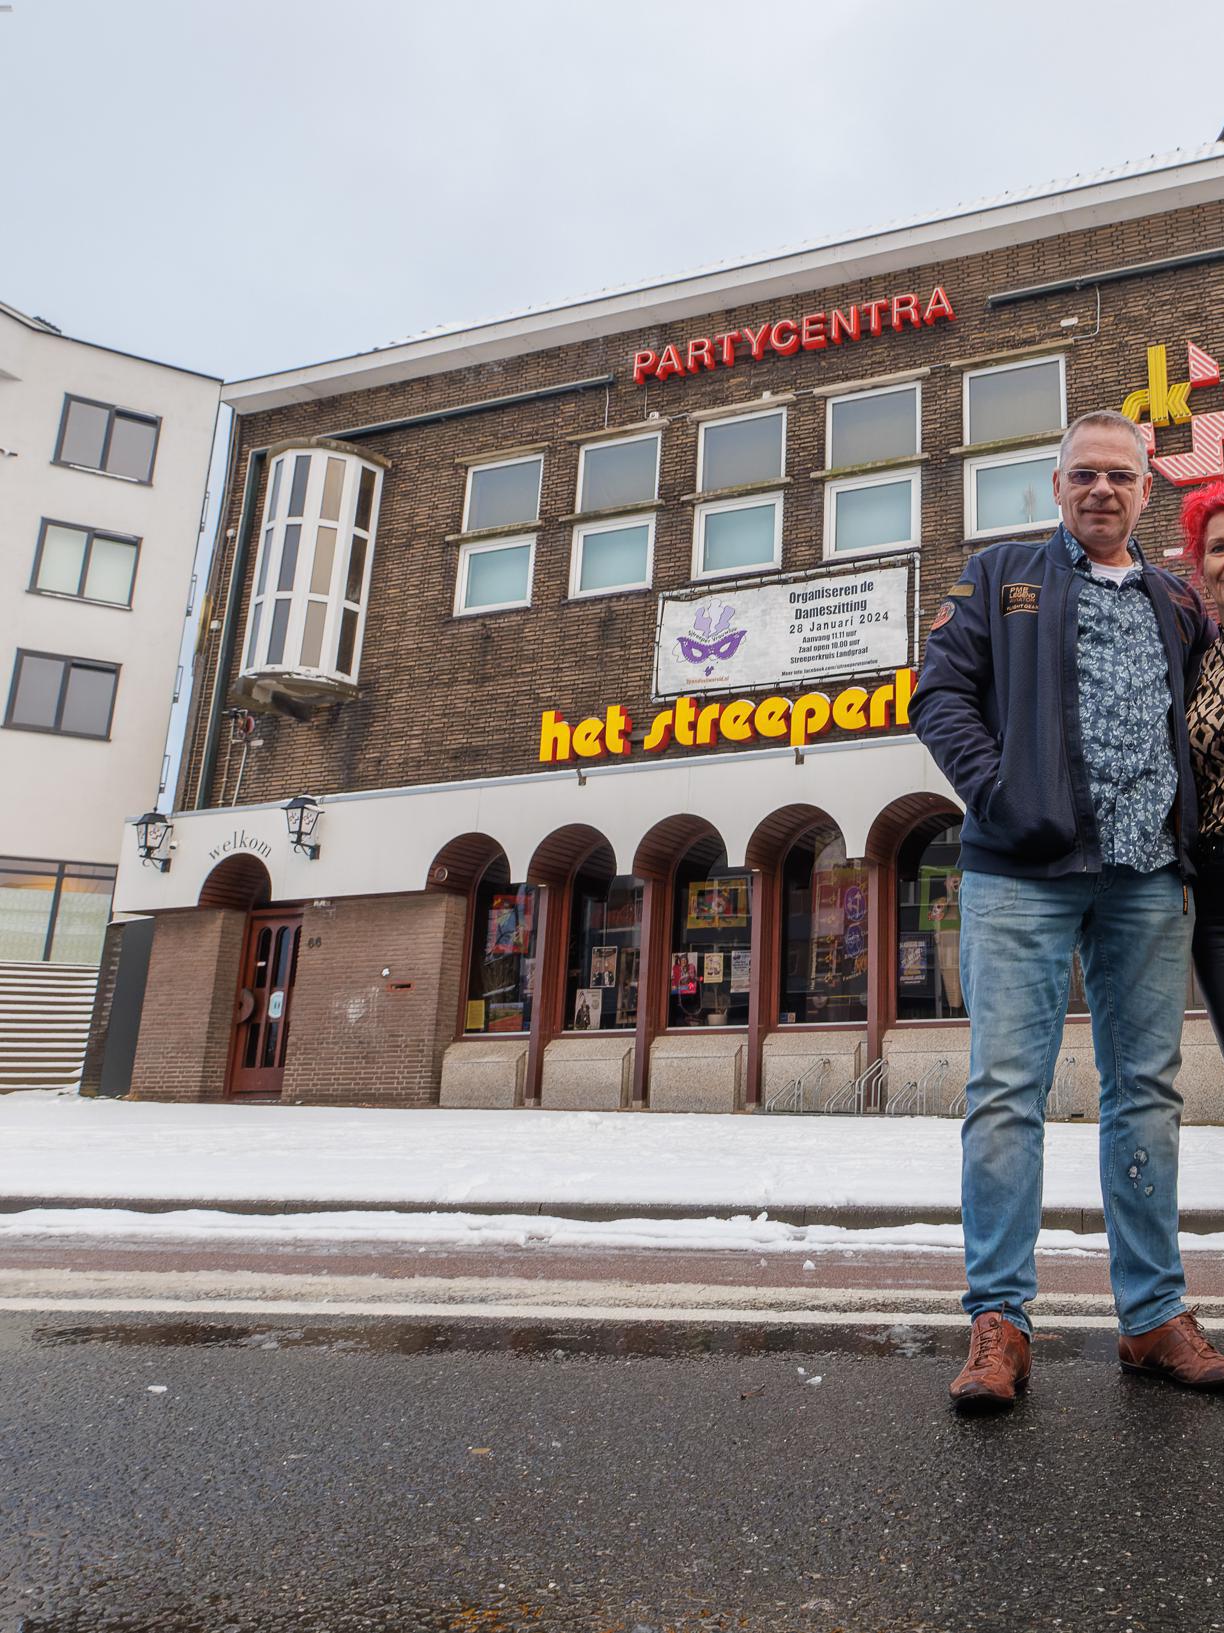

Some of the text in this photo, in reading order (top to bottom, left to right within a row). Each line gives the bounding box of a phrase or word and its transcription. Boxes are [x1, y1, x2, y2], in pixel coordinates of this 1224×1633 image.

[633, 287, 956, 384] PARTYCENTRA
[789, 580, 874, 604] Organiseren de
[794, 599, 867, 620] Dameszitting
[789, 611, 889, 634] 28 Januari 2024
[798, 644, 812, 654] Zaal
[813, 642, 830, 652] open
[802, 630, 857, 644] Aanvang 11.11 uur
[790, 646, 868, 664] Streeperkruis Landgraaf
[539, 704, 632, 763] het
[208, 829, 272, 860] welkom
